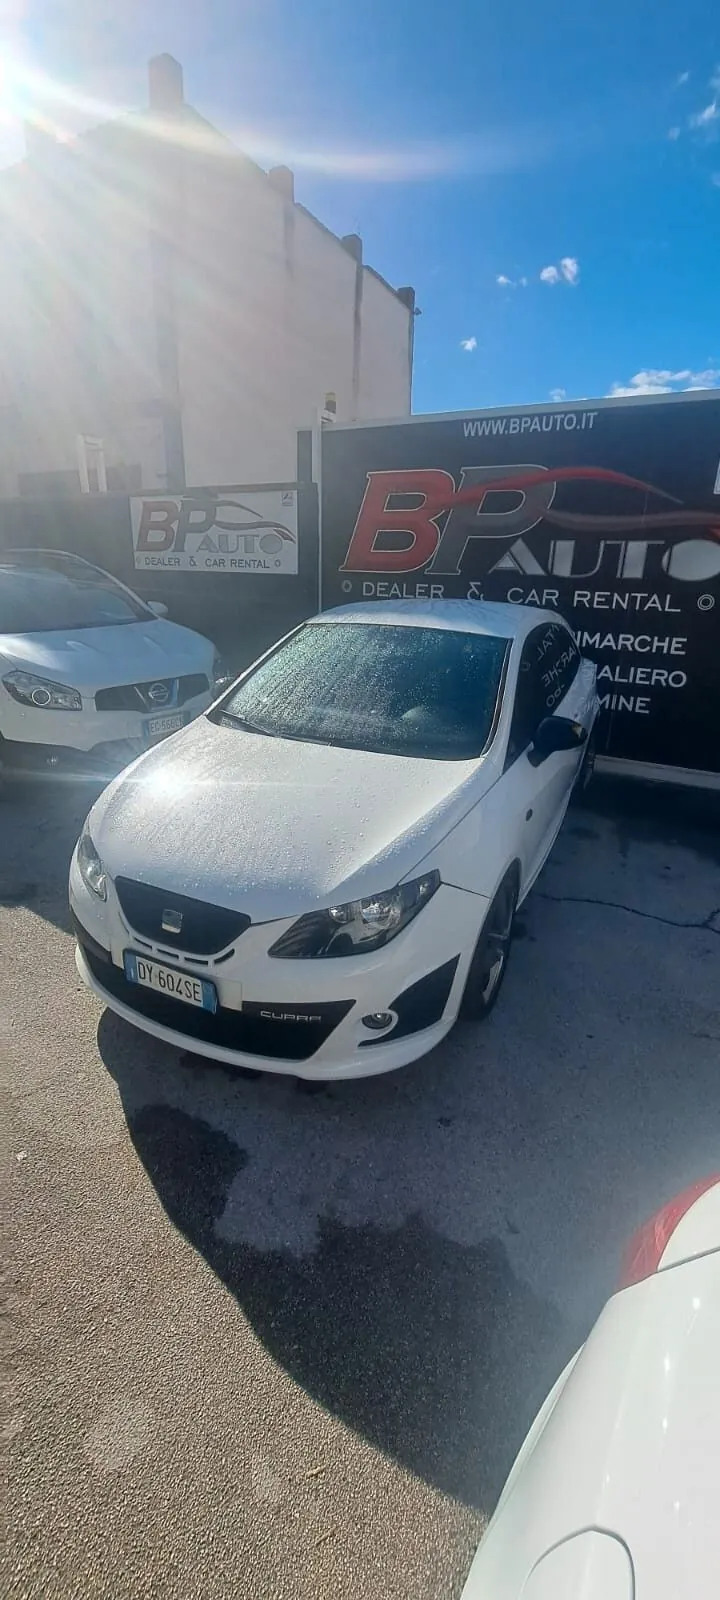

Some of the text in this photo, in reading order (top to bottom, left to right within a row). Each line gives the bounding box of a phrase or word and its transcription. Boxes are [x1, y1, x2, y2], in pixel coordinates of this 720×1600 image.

[463, 412, 598, 437] WWW.BPAUTO.IT
[136, 500, 283, 555] BP AUTO
[338, 463, 720, 582] BP AUTO
[145, 556, 270, 569] DEALER & CAR RENTAL
[362, 581, 681, 613] DEALER & CAR RENTAL
[595, 664, 687, 689] ALIERO
[138, 961, 153, 983] DY
[158, 970, 202, 1002] 604SE
[260, 1010, 322, 1022] CUPRA
